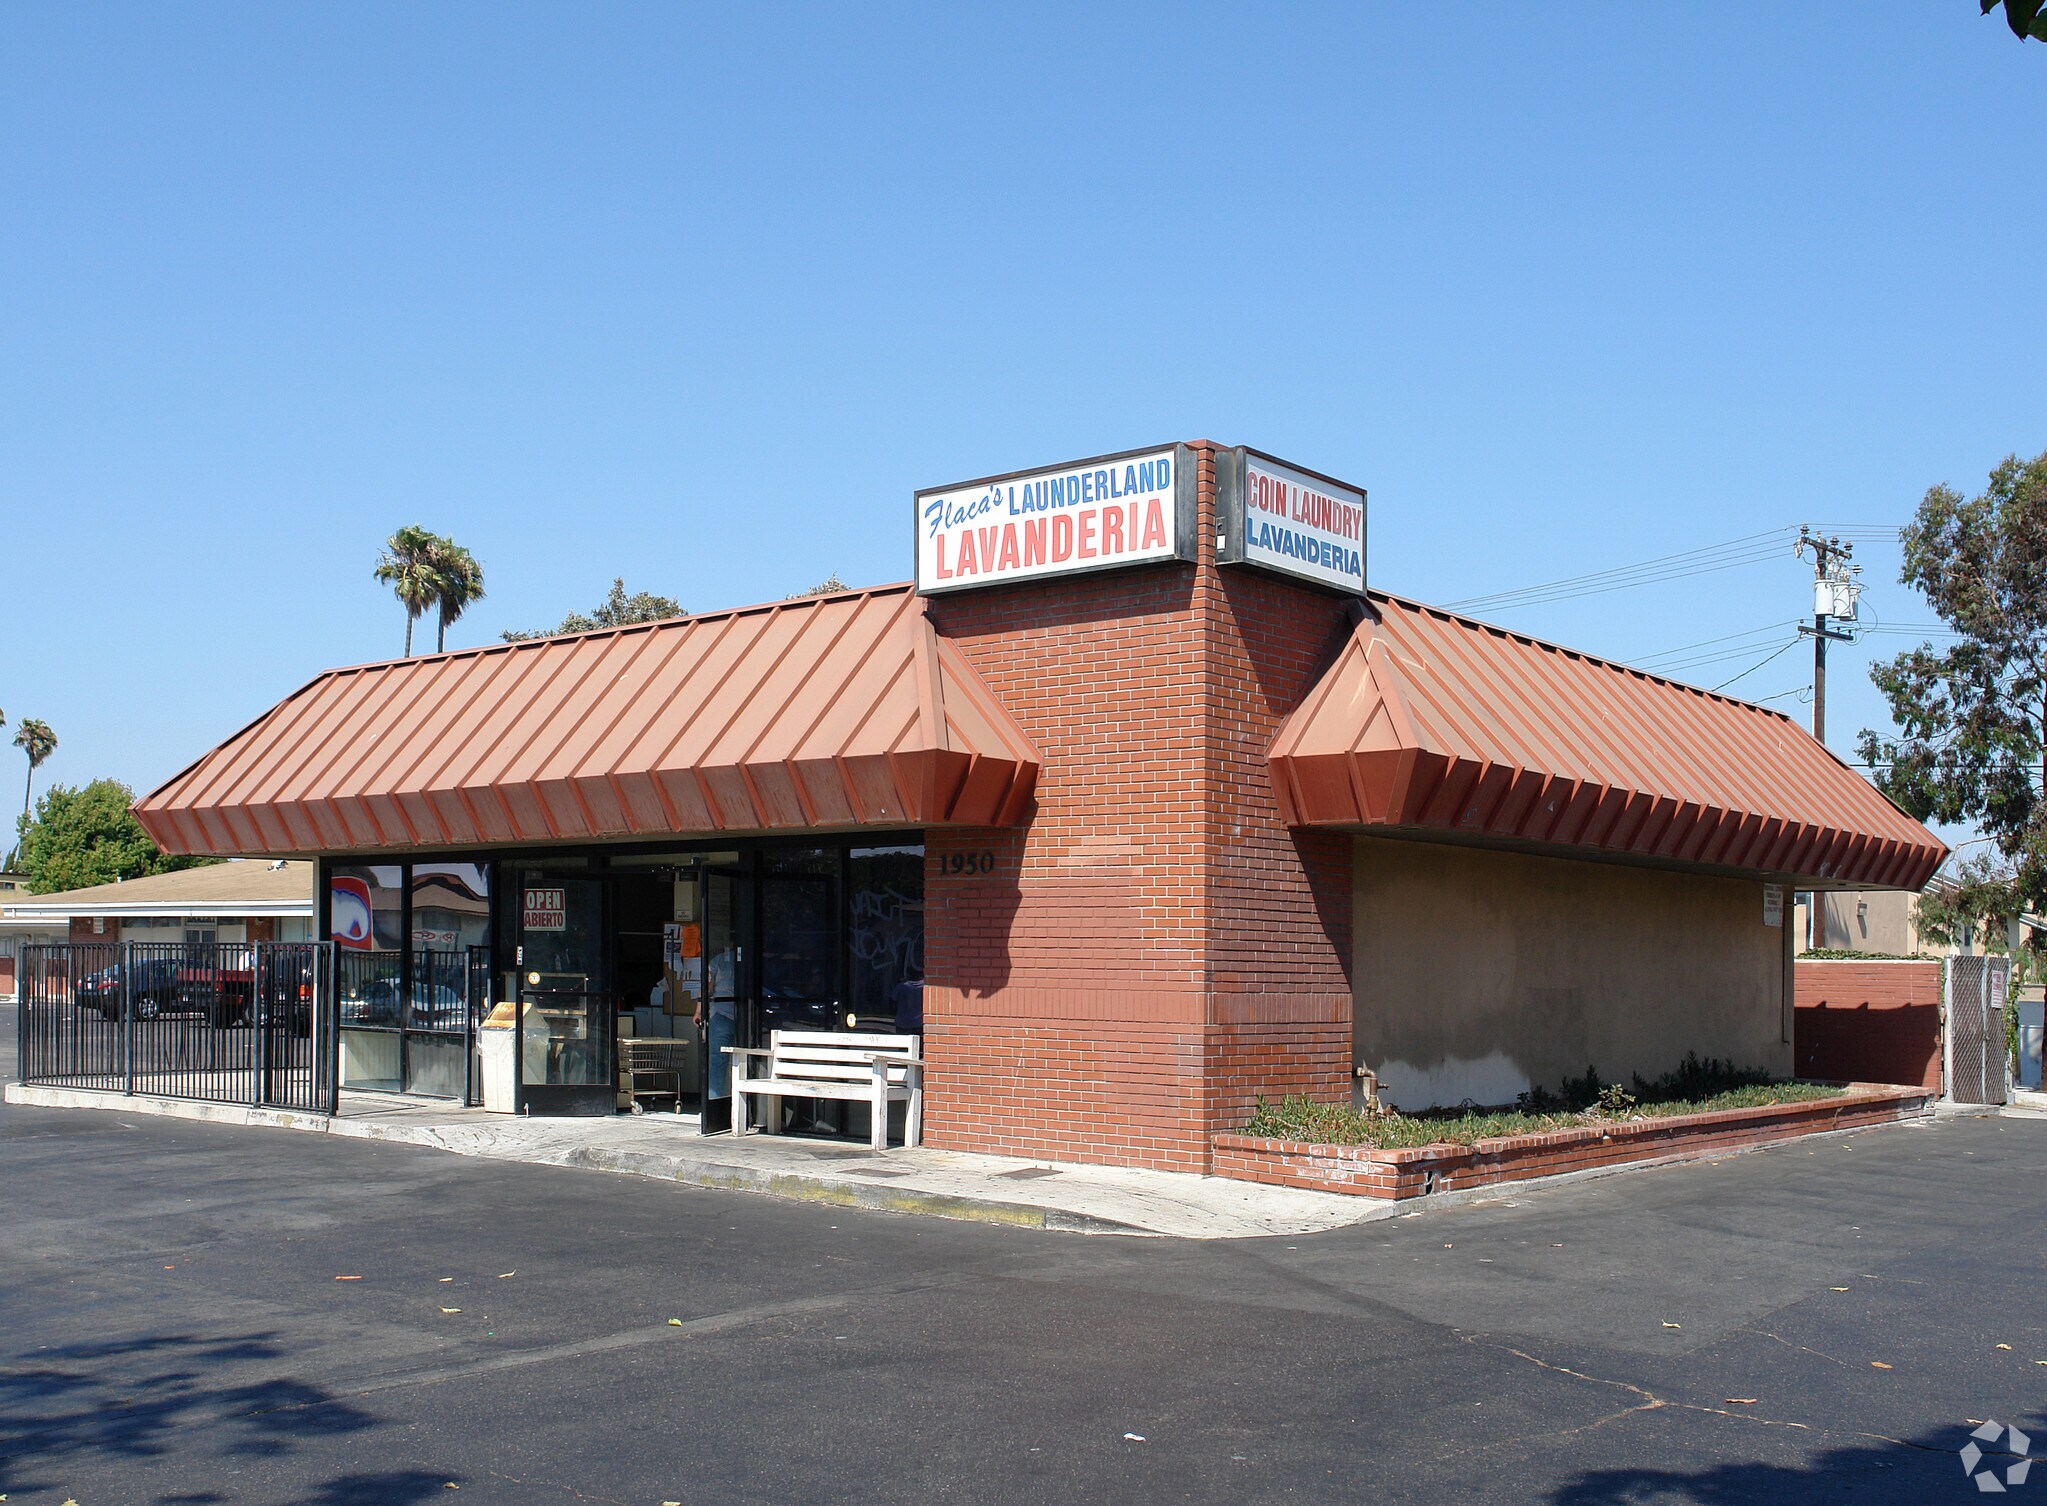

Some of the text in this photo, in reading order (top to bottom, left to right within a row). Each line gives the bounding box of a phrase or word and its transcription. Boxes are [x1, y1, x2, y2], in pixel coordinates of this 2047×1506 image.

[925, 458, 1170, 539] Flaca's LAUNDERLAND
[1246, 471, 1362, 541] COIN LAUNDRY
[936, 498, 1167, 580] LAVANDERIA
[1247, 516, 1362, 578] LAVANDERIA
[940, 852, 995, 876] 1950
[524, 912, 564, 928] ABIERTO
[526, 891, 561, 909] OPEN
